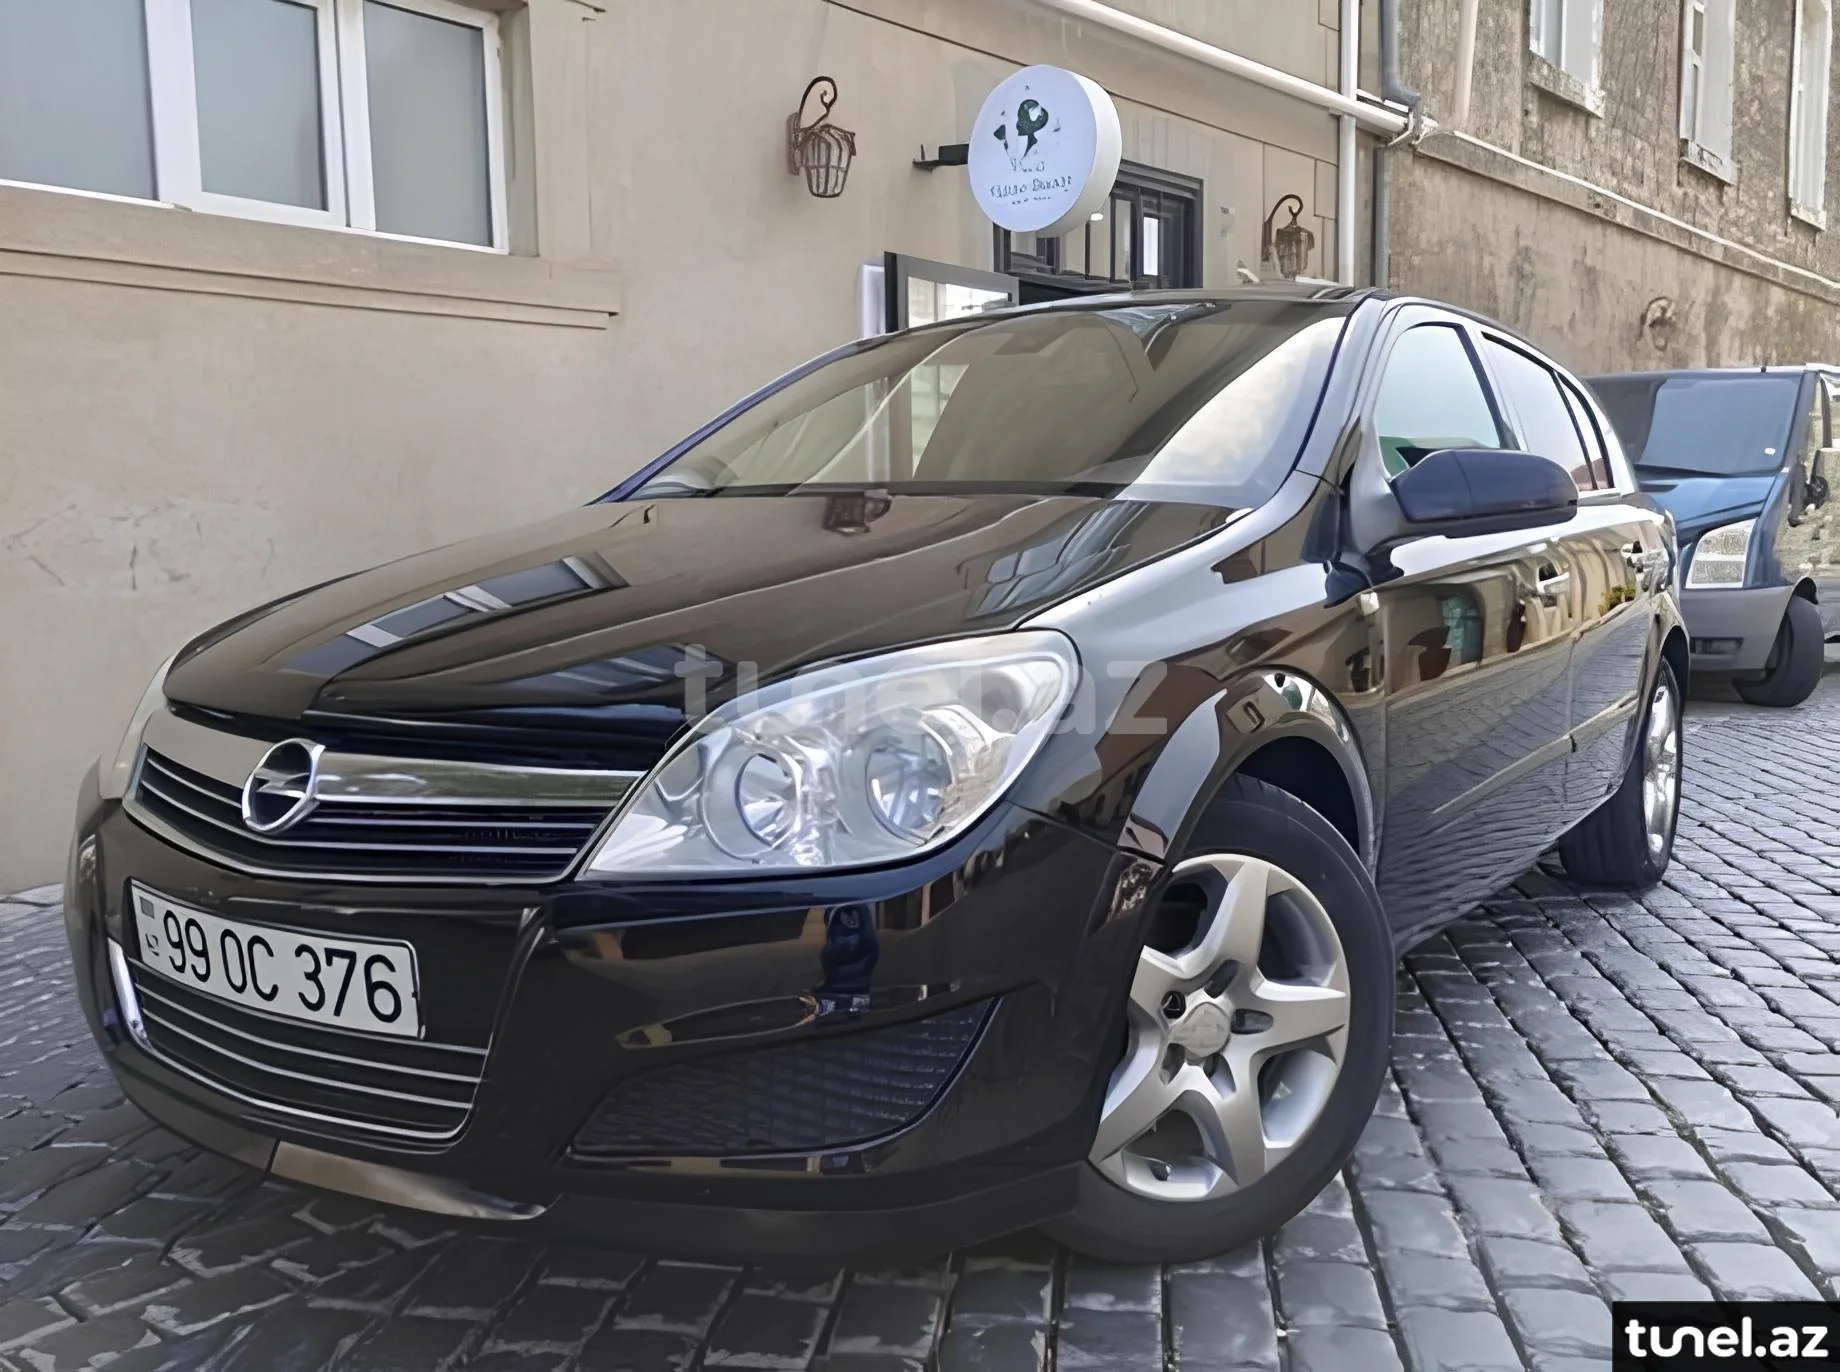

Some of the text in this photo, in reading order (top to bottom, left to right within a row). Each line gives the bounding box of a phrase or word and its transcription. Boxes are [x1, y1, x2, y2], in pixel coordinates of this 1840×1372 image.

[163, 909, 402, 1023] 99 OC 376
